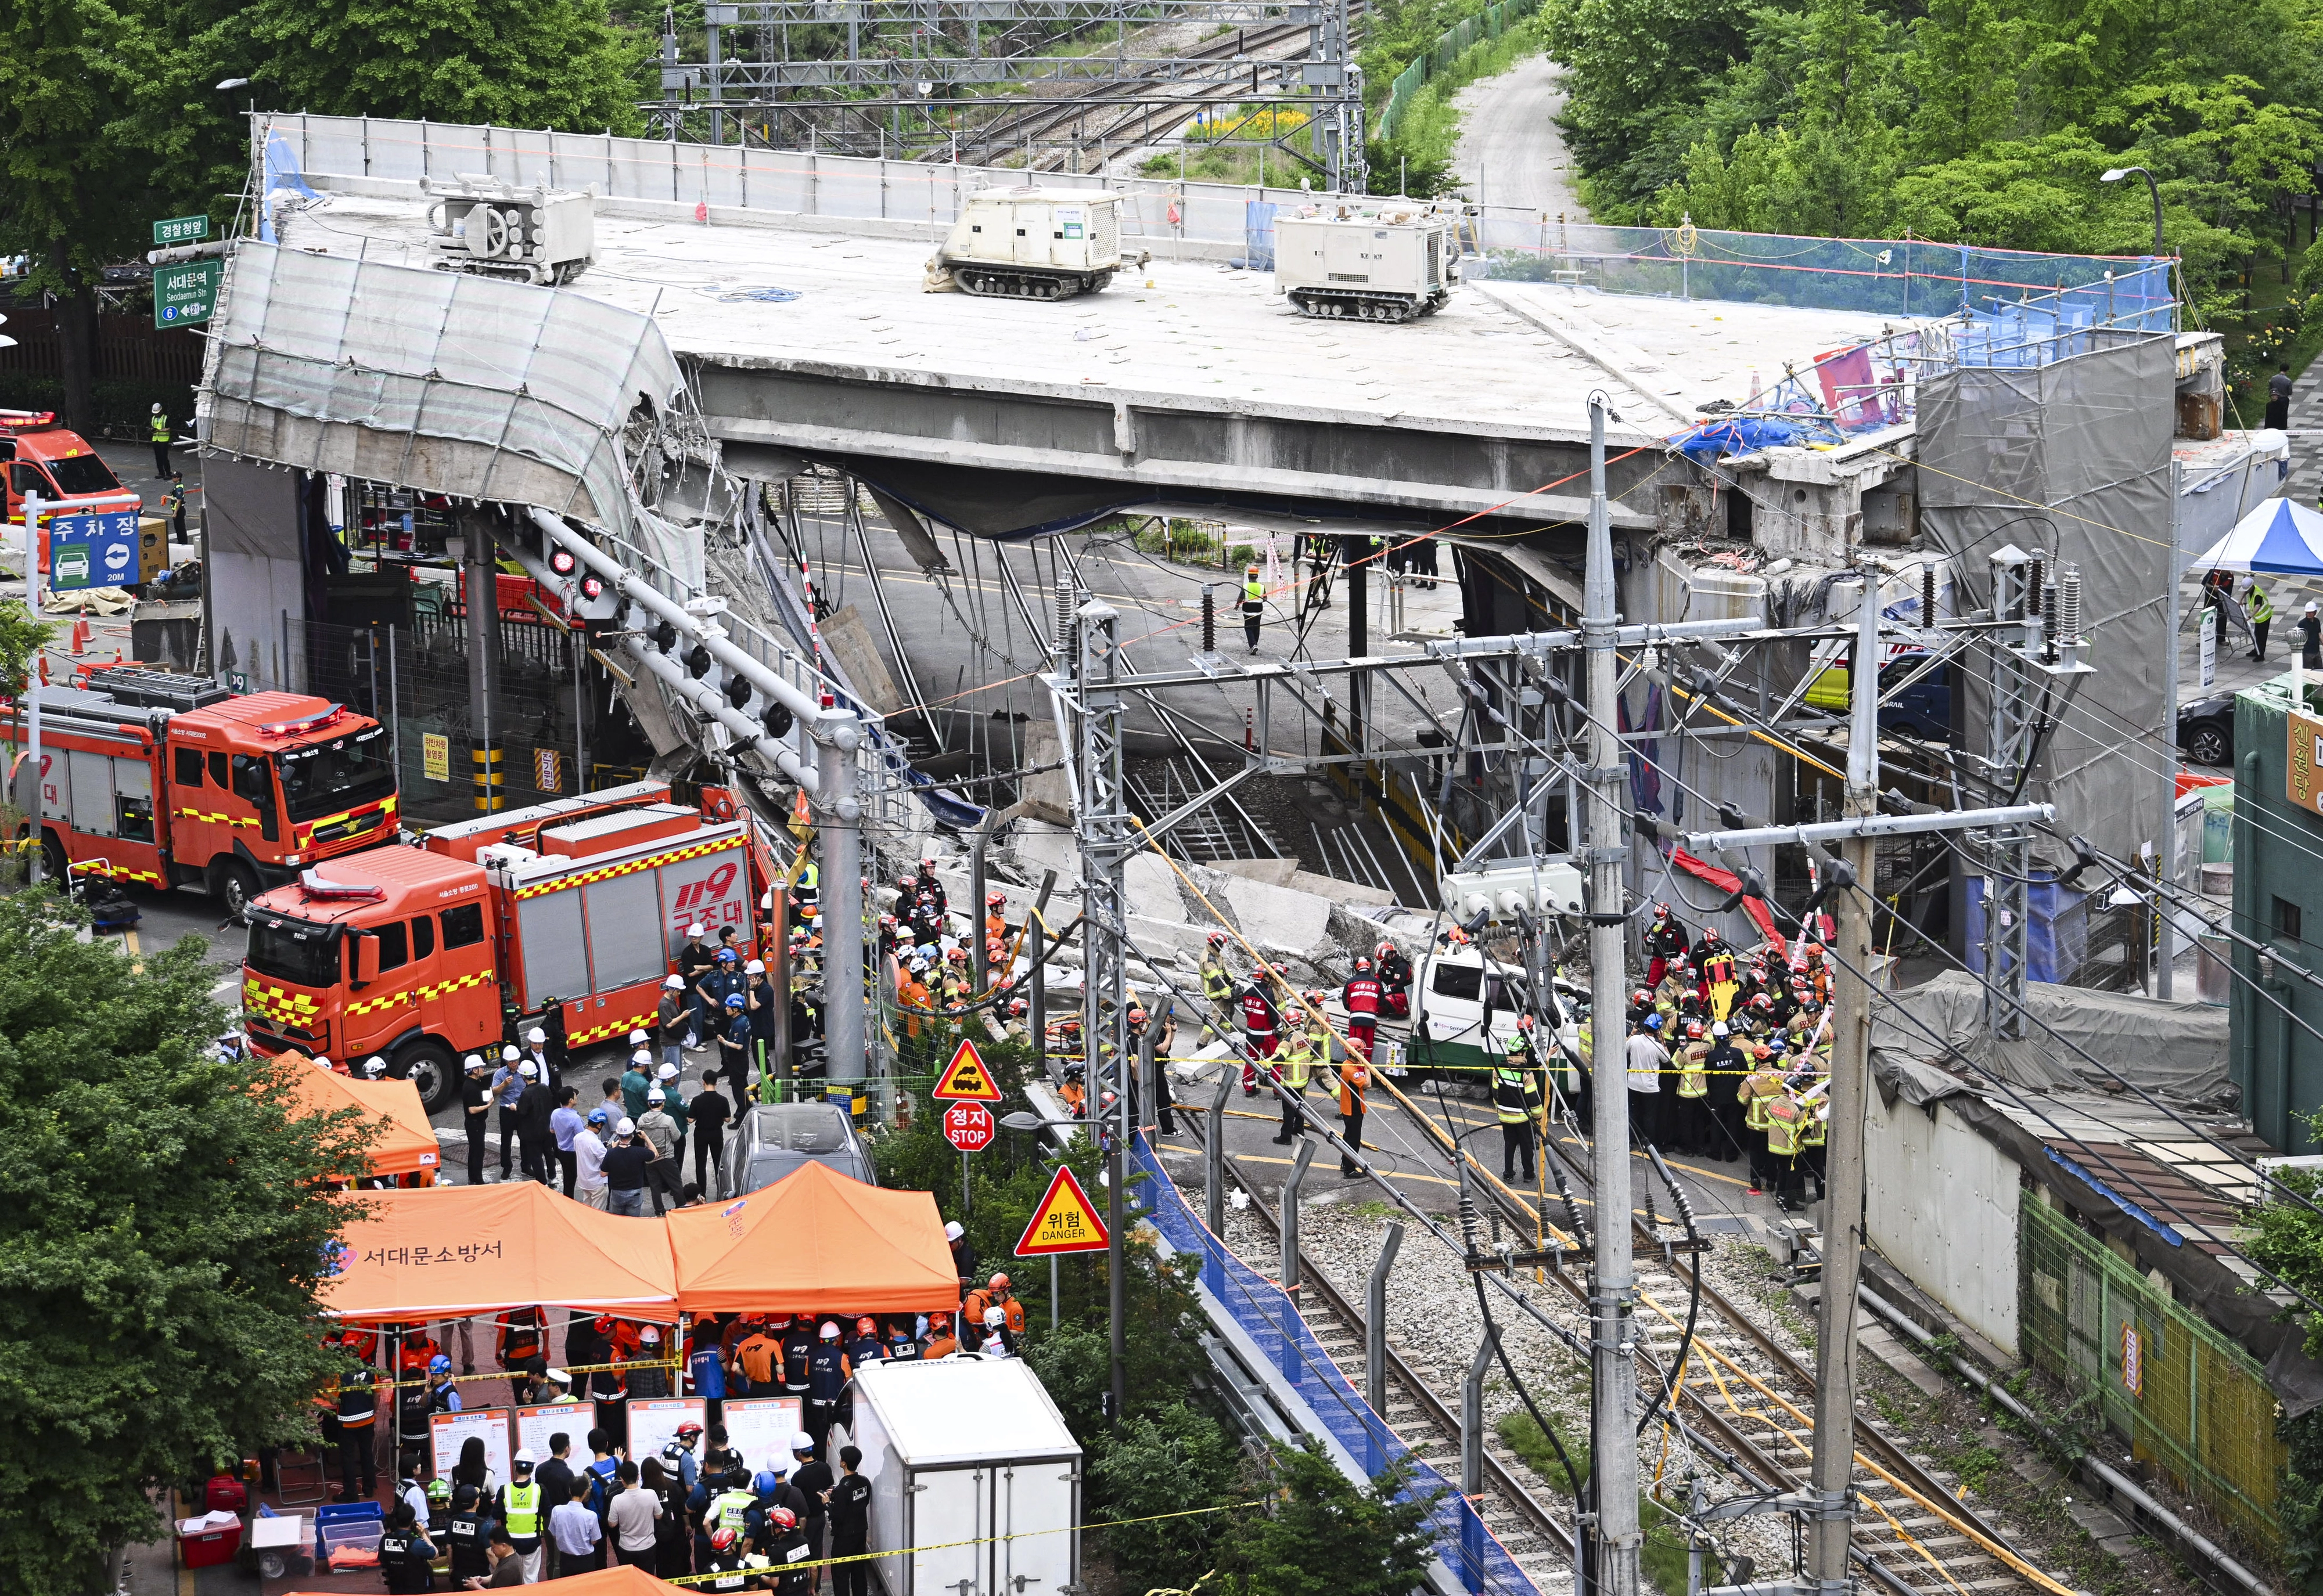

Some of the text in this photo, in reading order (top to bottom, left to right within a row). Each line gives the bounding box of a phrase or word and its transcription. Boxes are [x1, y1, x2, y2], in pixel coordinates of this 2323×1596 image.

[162, 221, 202, 238] 경찰청앞
[167, 271, 207, 290] 서대문역
[167, 289, 207, 302] Seodaemun Stn
[167, 308, 172, 318] 6
[192, 305, 199, 314] 21
[107, 573, 124, 581] 20M
[425, 737, 446, 750] 위반차량
[542, 753, 554, 788] 전기위험
[439, 883, 479, 898] 서울소방 종로200
[673, 862, 738, 913] 119
[674, 899, 743, 938] 구조대
[1245, 999, 1266, 1007] 서울소방
[951, 1109, 986, 1127] 정지
[951, 1130, 986, 1143] STOP
[1048, 1211, 1080, 1228] 위험
[1042, 1228, 1085, 1240] DANGER
[364, 1240, 501, 1266] 서대문소방서
[859, 1351, 873, 1359] 119
[455, 1522, 472, 1531] 경찰
